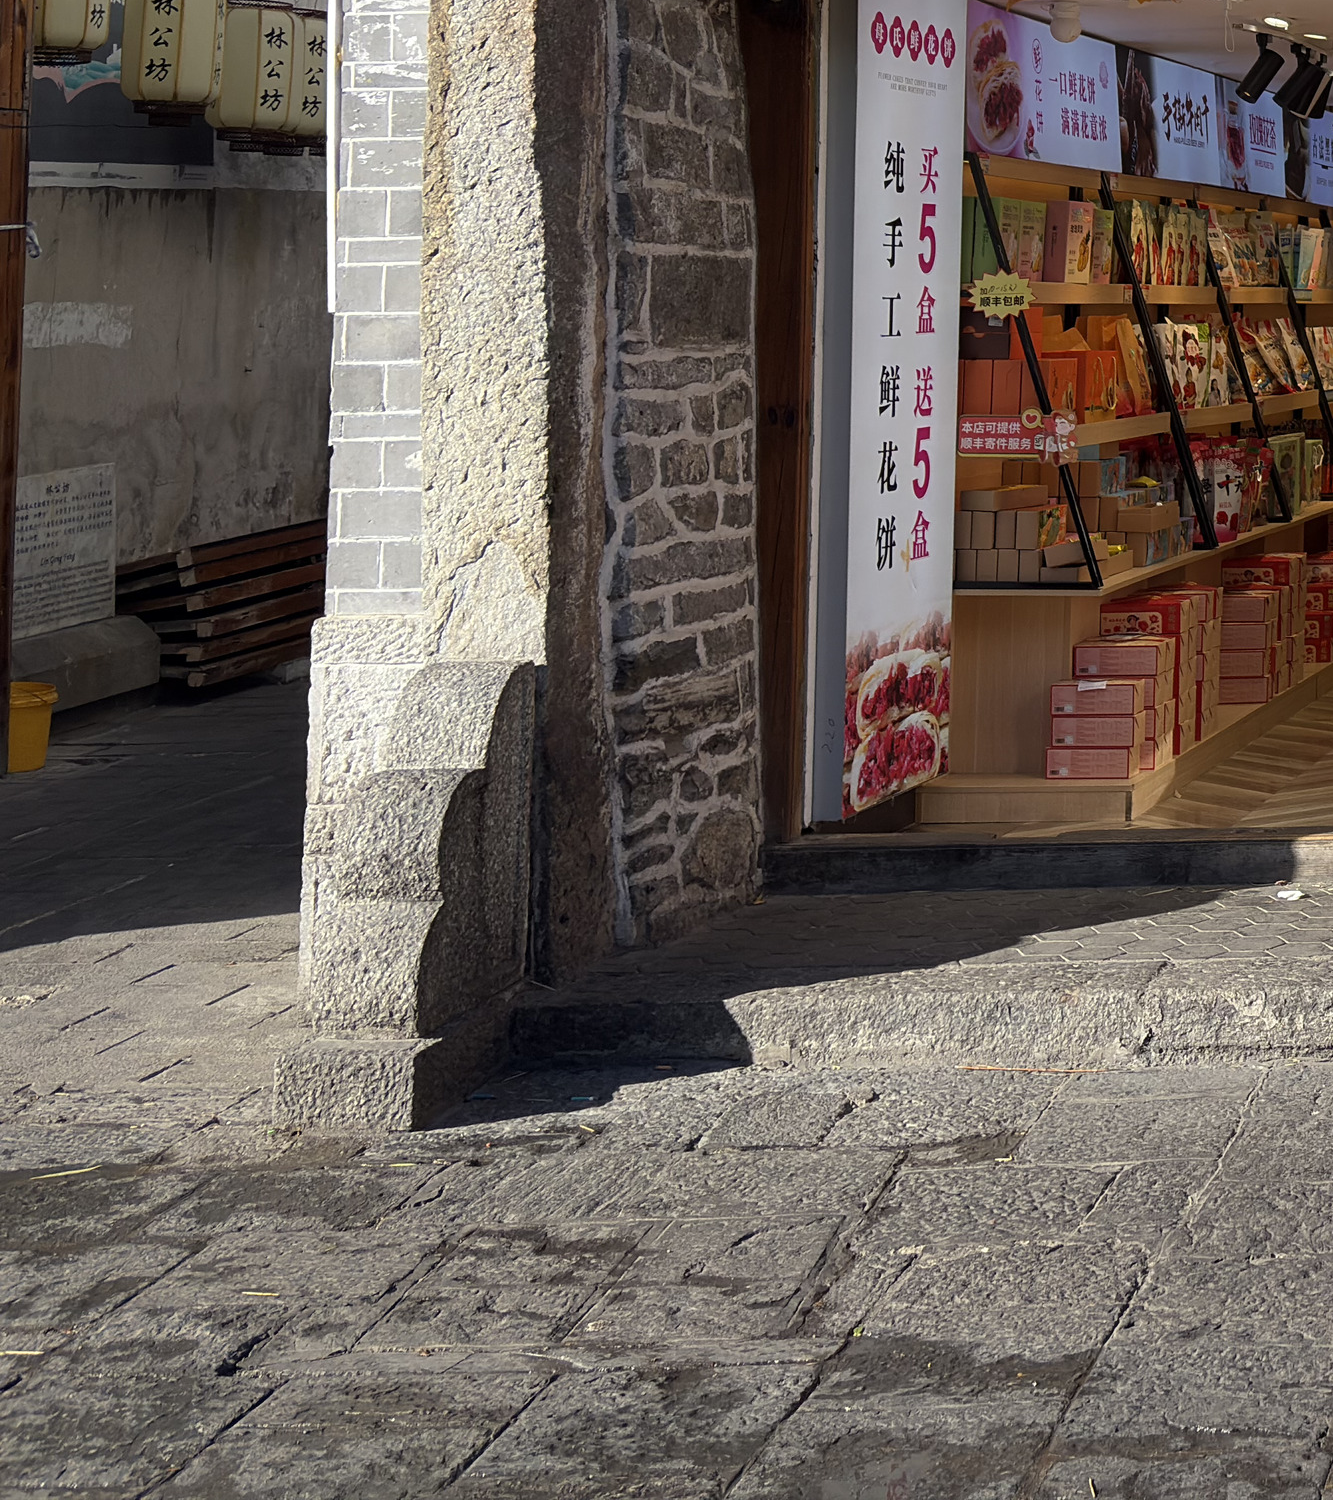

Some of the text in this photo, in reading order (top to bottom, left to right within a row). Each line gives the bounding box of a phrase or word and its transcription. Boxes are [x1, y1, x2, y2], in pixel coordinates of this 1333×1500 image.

[874, 20, 953, 60] 母氏鲜花饼
[260, 26, 289, 112] 林公坊
[302, 34, 328, 118] 林公坊
[1049, 71, 1096, 105] 一口鲜花饼
[1061, 107, 1108, 142] 满满花意浓
[1249, 113, 1277, 150] 玫瑰花茶
[979, 295, 1025, 308] 顺丰包邮
[875, 140, 906, 572] 纯手工鲜花饼
[960, 437, 1031, 451] 顺丰寄件服务
[961, 420, 1021, 435] 本店可提供
